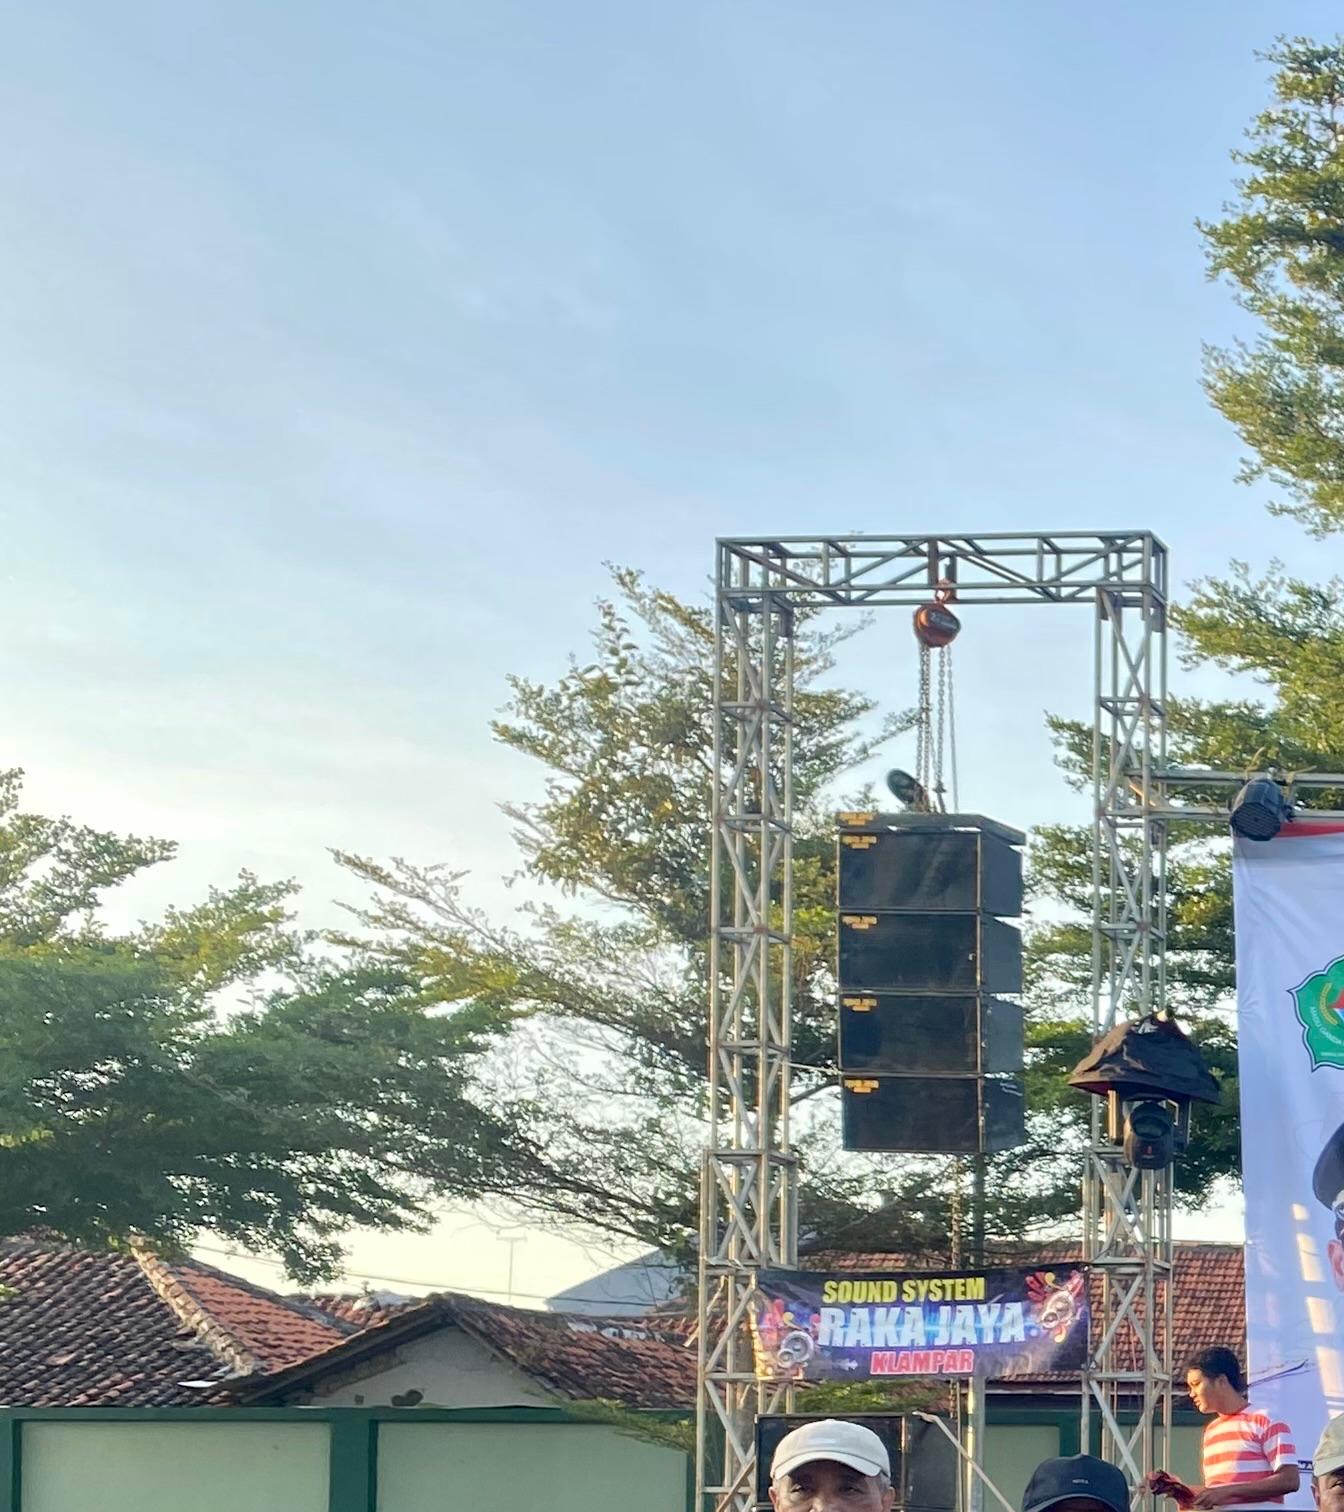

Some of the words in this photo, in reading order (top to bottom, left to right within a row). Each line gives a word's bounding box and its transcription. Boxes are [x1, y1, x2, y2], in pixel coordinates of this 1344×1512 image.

[822, 1280, 897, 1304] SOUND
[902, 1277, 985, 1303] SYSTEM
[818, 1305, 927, 1348] RAKA
[931, 1302, 1025, 1346] JAYA
[870, 1349, 974, 1376] KLAMPAR
